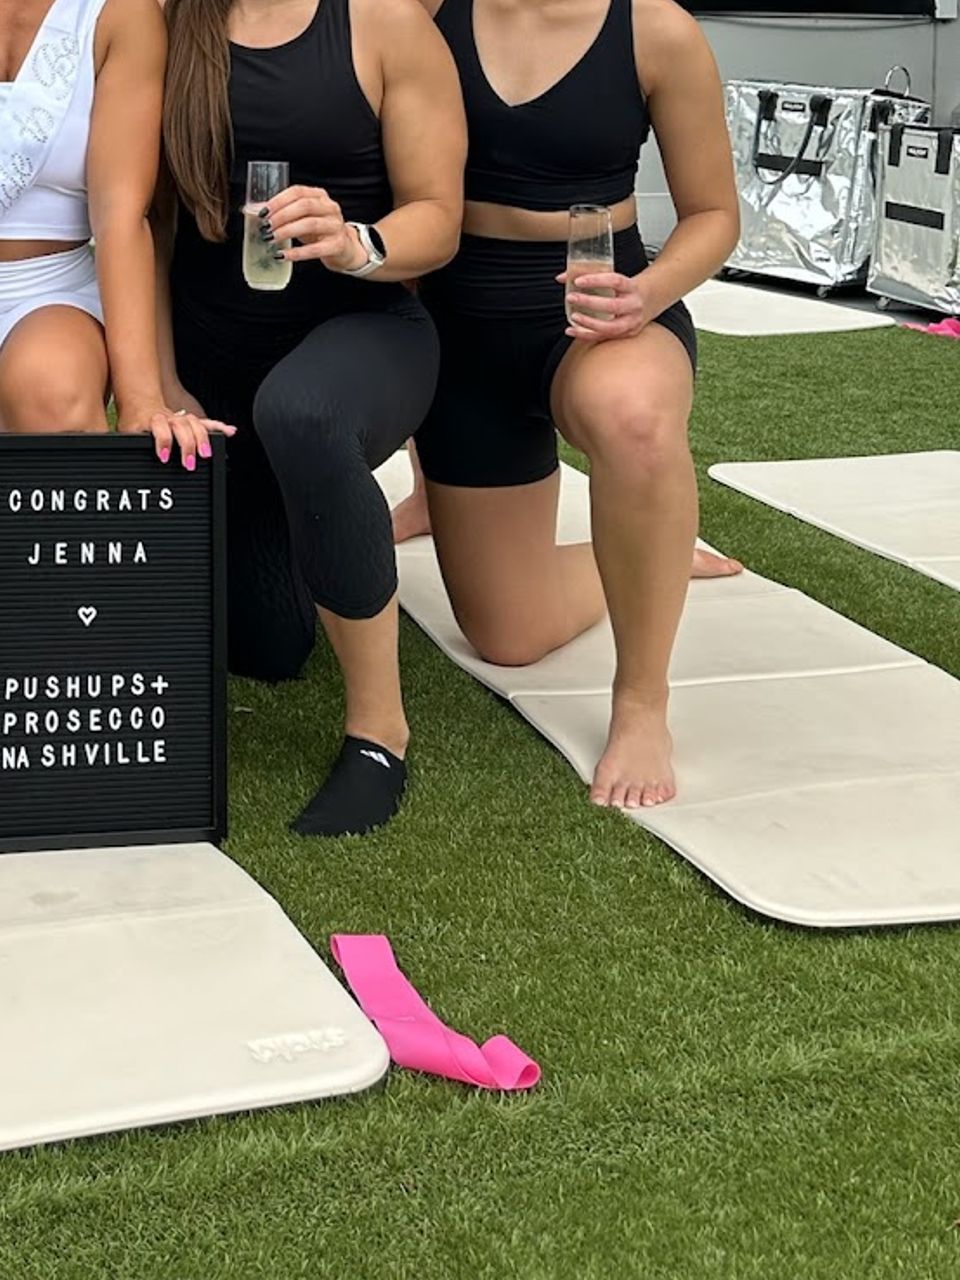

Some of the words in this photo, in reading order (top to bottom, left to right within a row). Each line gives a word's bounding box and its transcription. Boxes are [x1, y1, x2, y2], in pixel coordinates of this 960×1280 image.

[8, 488, 173, 512] CONGRATS
[27, 541, 147, 565] JENNA
[4, 673, 169, 701] PUSHUPS+
[3, 706, 165, 735] PROSECCO
